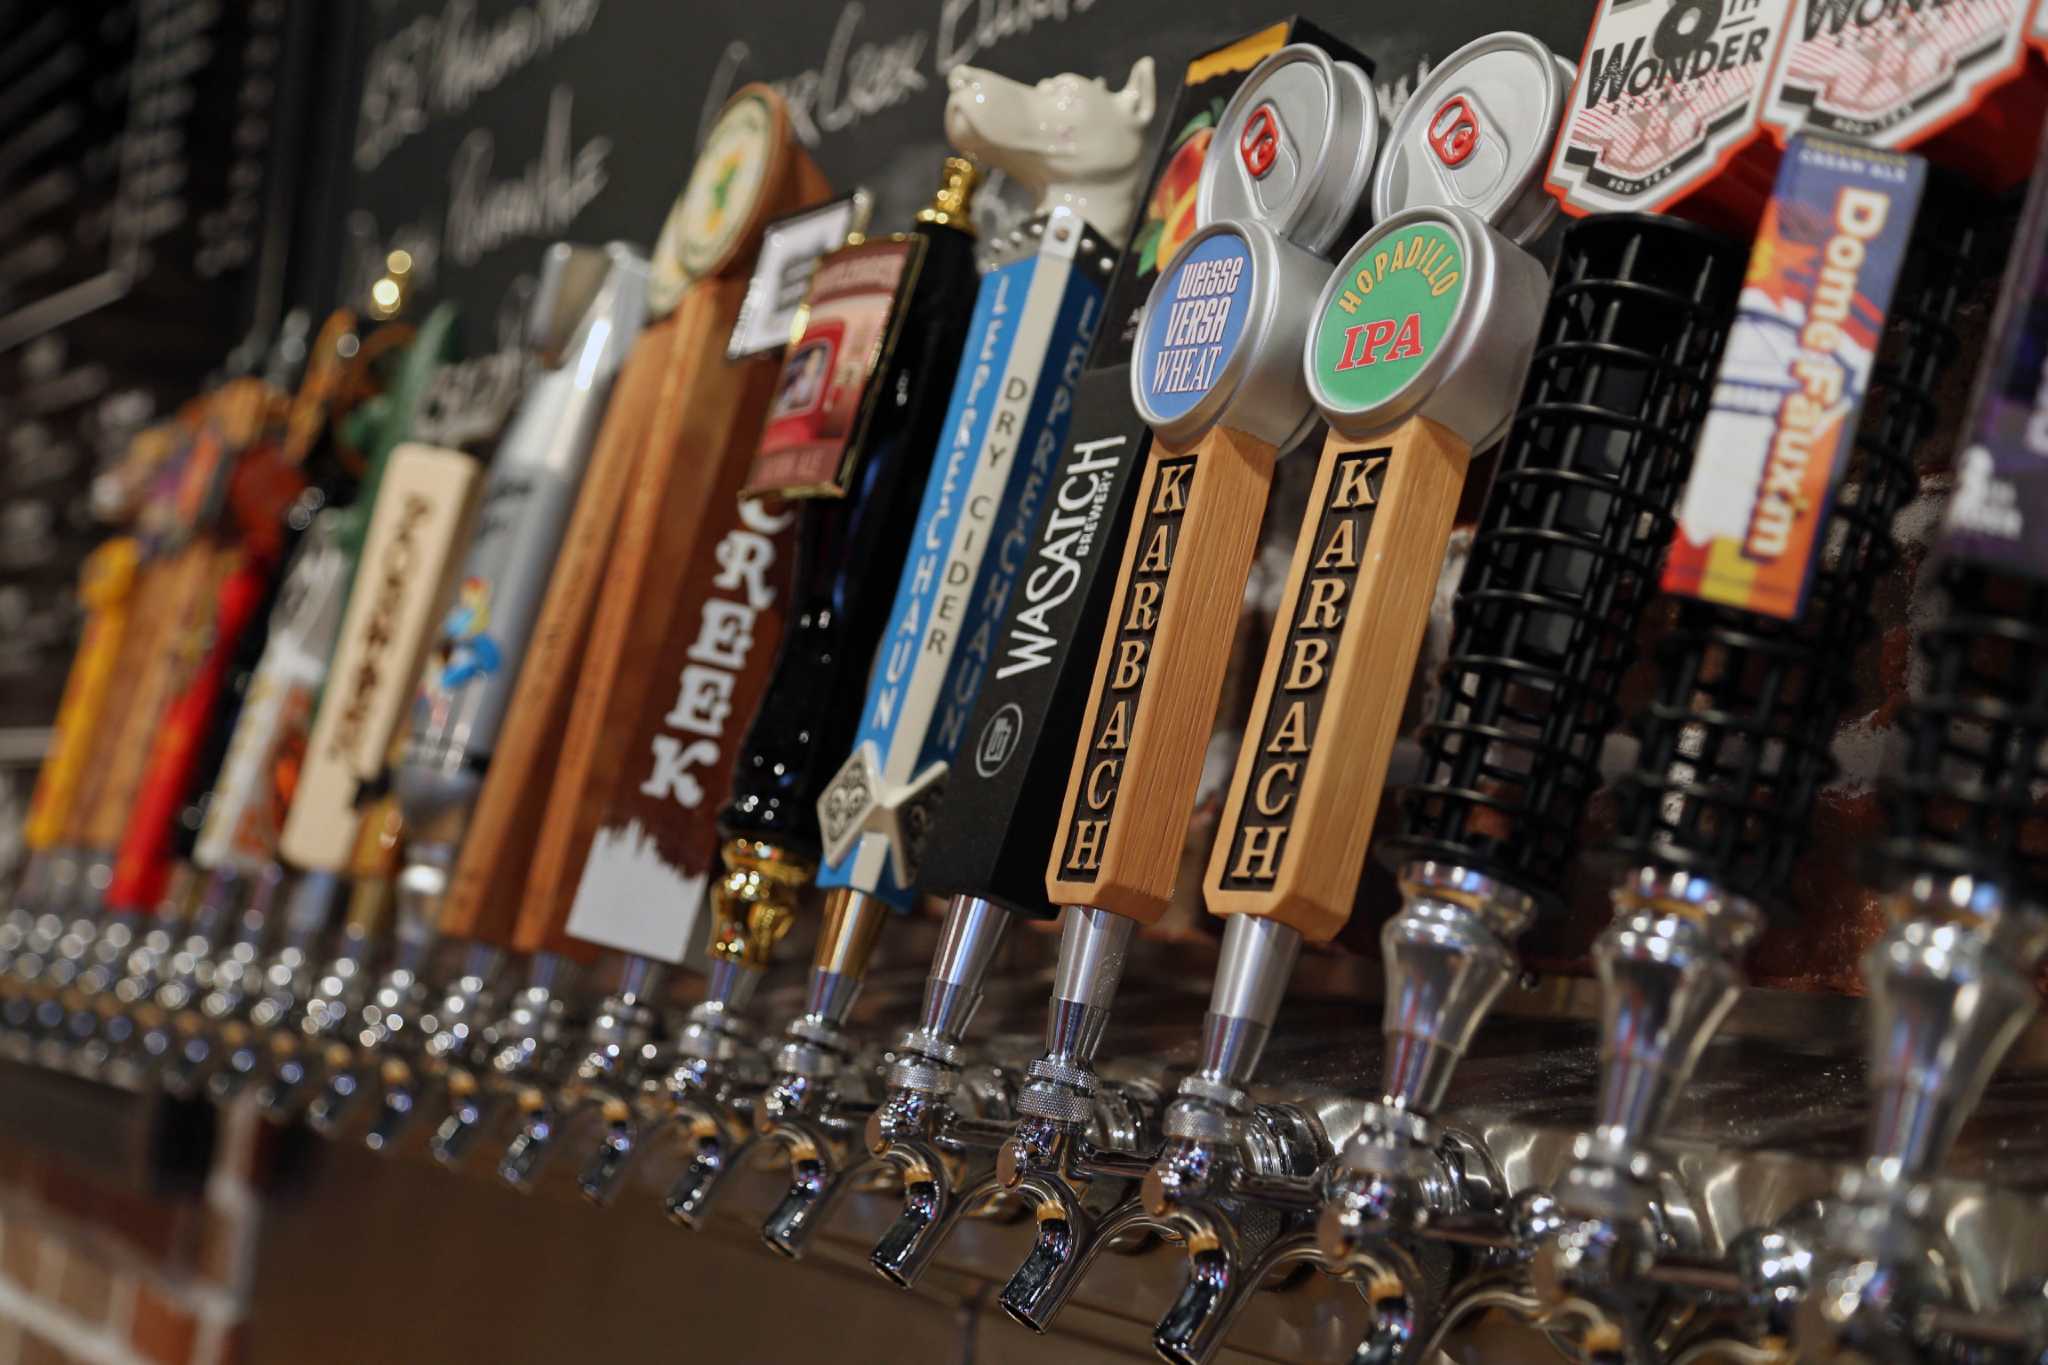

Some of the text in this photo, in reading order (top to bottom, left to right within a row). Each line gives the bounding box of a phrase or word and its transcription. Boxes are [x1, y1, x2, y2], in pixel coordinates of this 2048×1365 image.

[1585, 27, 1770, 109] WONDER
[1165, 296, 1232, 347] VERSA
[1338, 236, 1460, 315] HOPADILLO
[1803, 185, 1891, 350] Dome
[1152, 346, 1222, 393] WHEAT
[1334, 312, 1424, 372] IPA
[872, 274, 1010, 730] LEPRECHAUN
[926, 377, 1028, 656] DRY CIDER
[996, 435, 1126, 679] WASATCH
[1075, 470, 1114, 557] BREWERY
[1066, 463, 1194, 870] KARBACH
[1231, 457, 1385, 880] KARBACH
